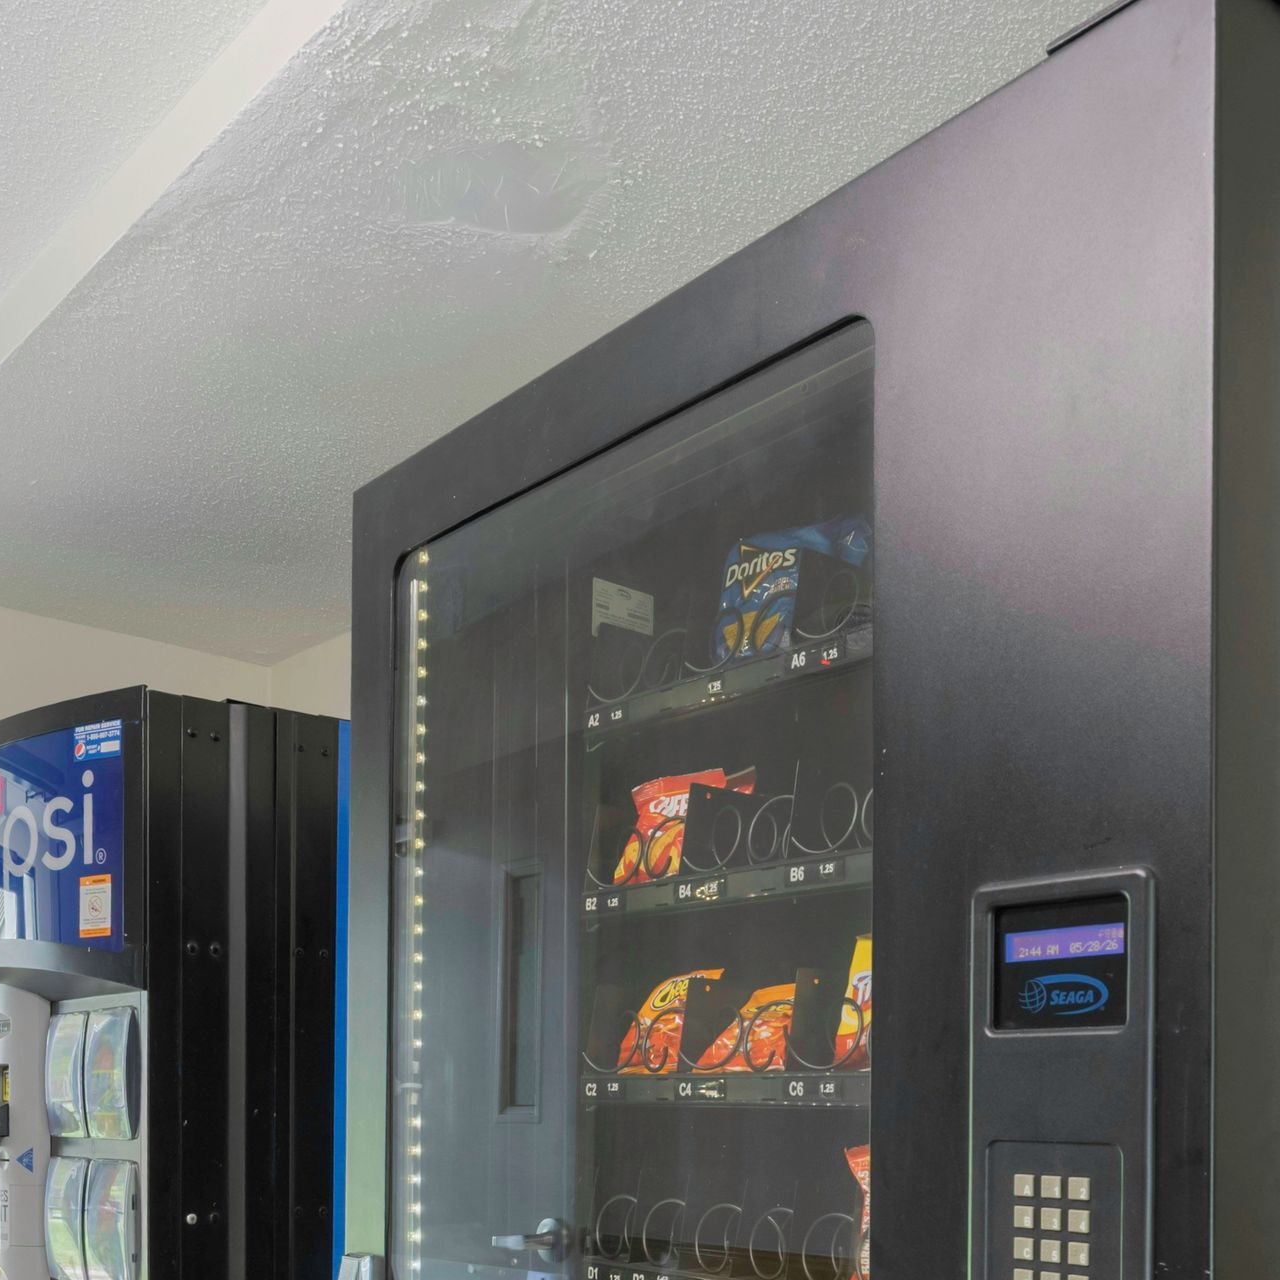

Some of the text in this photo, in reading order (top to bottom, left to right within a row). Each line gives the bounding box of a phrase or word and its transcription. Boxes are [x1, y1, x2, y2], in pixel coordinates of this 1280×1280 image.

[725, 548, 798, 588] Doritos
[791, 648, 838, 669] A6 1.25
[708, 681, 722, 693] 1.25
[588, 710, 622, 728] A2 1.25
[790, 863, 834, 882] B6 1.25
[679, 884, 691, 898] B4
[585, 898, 618, 911] B2 1.25
[653, 979, 689, 1008] Chee
[1050, 990, 1094, 1005] SEAGA
[585, 1083, 619, 1096] C2 1.25
[679, 1082, 692, 1096] C4
[789, 1081, 834, 1096] C6 1.25
[1023, 1184, 1031, 1195] A
[1054, 1186, 1059, 1196] 1
[1080, 1187, 1086, 1199] 2
[1024, 1216, 1031, 1227] B
[1052, 1218, 1058, 1228] 3
[1079, 1221, 1086, 1231] 4
[1023, 1248, 1030, 1258] C
[1051, 1250, 1058, 1261] 5
[1080, 1253, 1086, 1264] 6
[588, 1266, 598, 1280] D1
